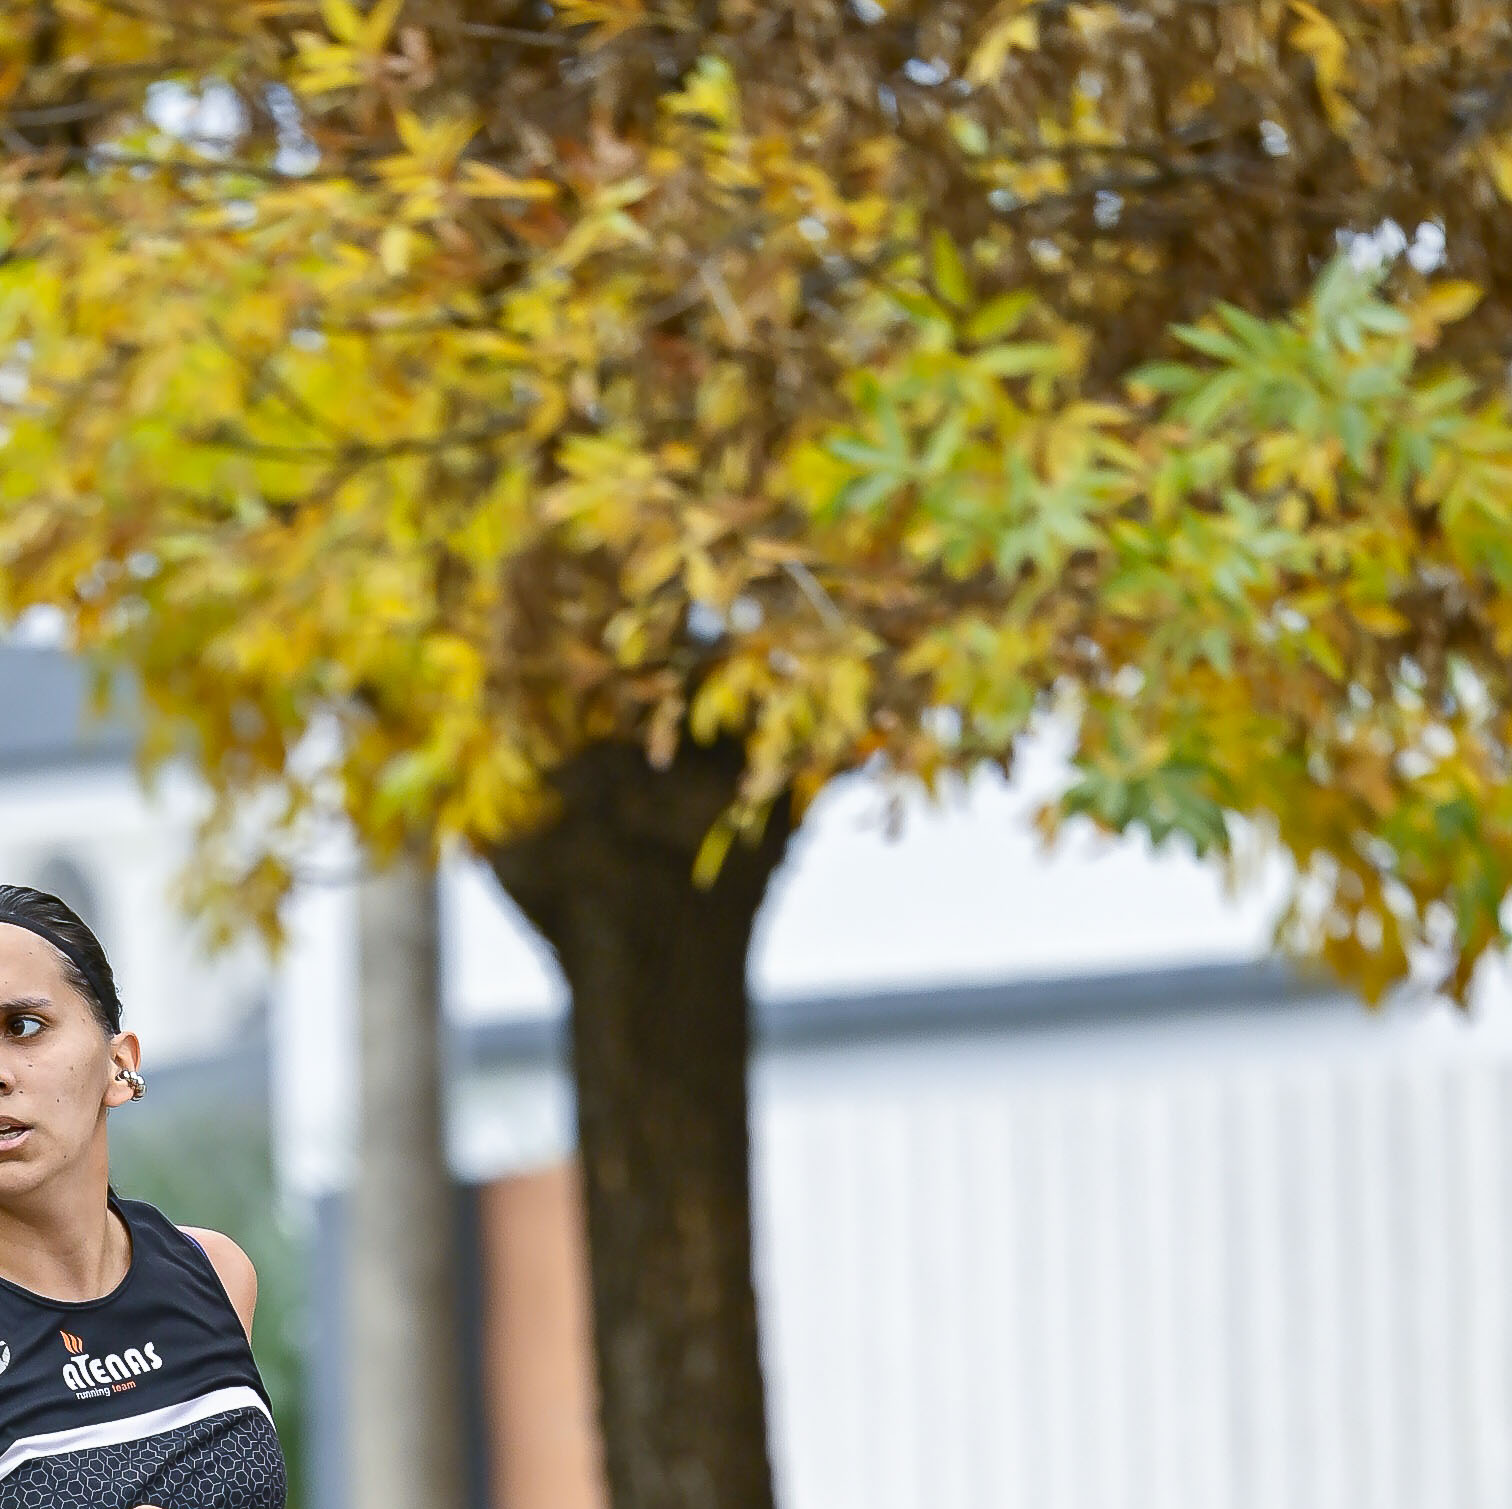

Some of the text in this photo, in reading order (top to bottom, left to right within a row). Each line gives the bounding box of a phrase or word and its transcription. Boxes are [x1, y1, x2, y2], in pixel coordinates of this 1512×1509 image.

[62, 1341, 163, 1391] ATENAS
[75, 1380, 137, 1400] running team
